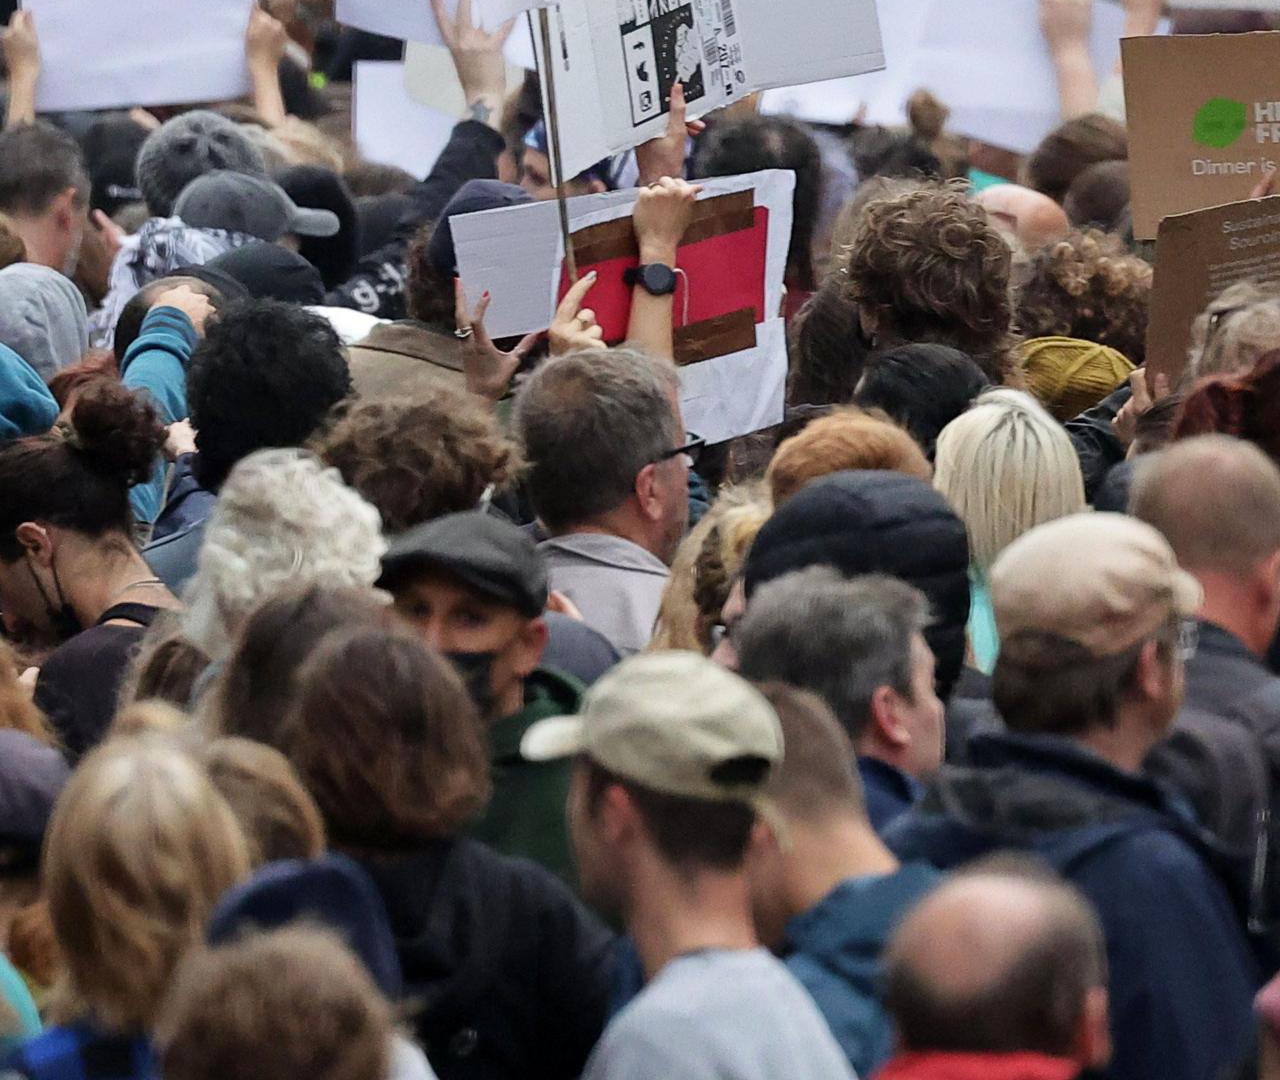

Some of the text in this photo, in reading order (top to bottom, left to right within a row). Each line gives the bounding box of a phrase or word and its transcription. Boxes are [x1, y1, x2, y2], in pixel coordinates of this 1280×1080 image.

[717, 43, 731, 70] 207
[1192, 159, 1256, 175] Dinner
[1261, 158, 1275, 173] is
